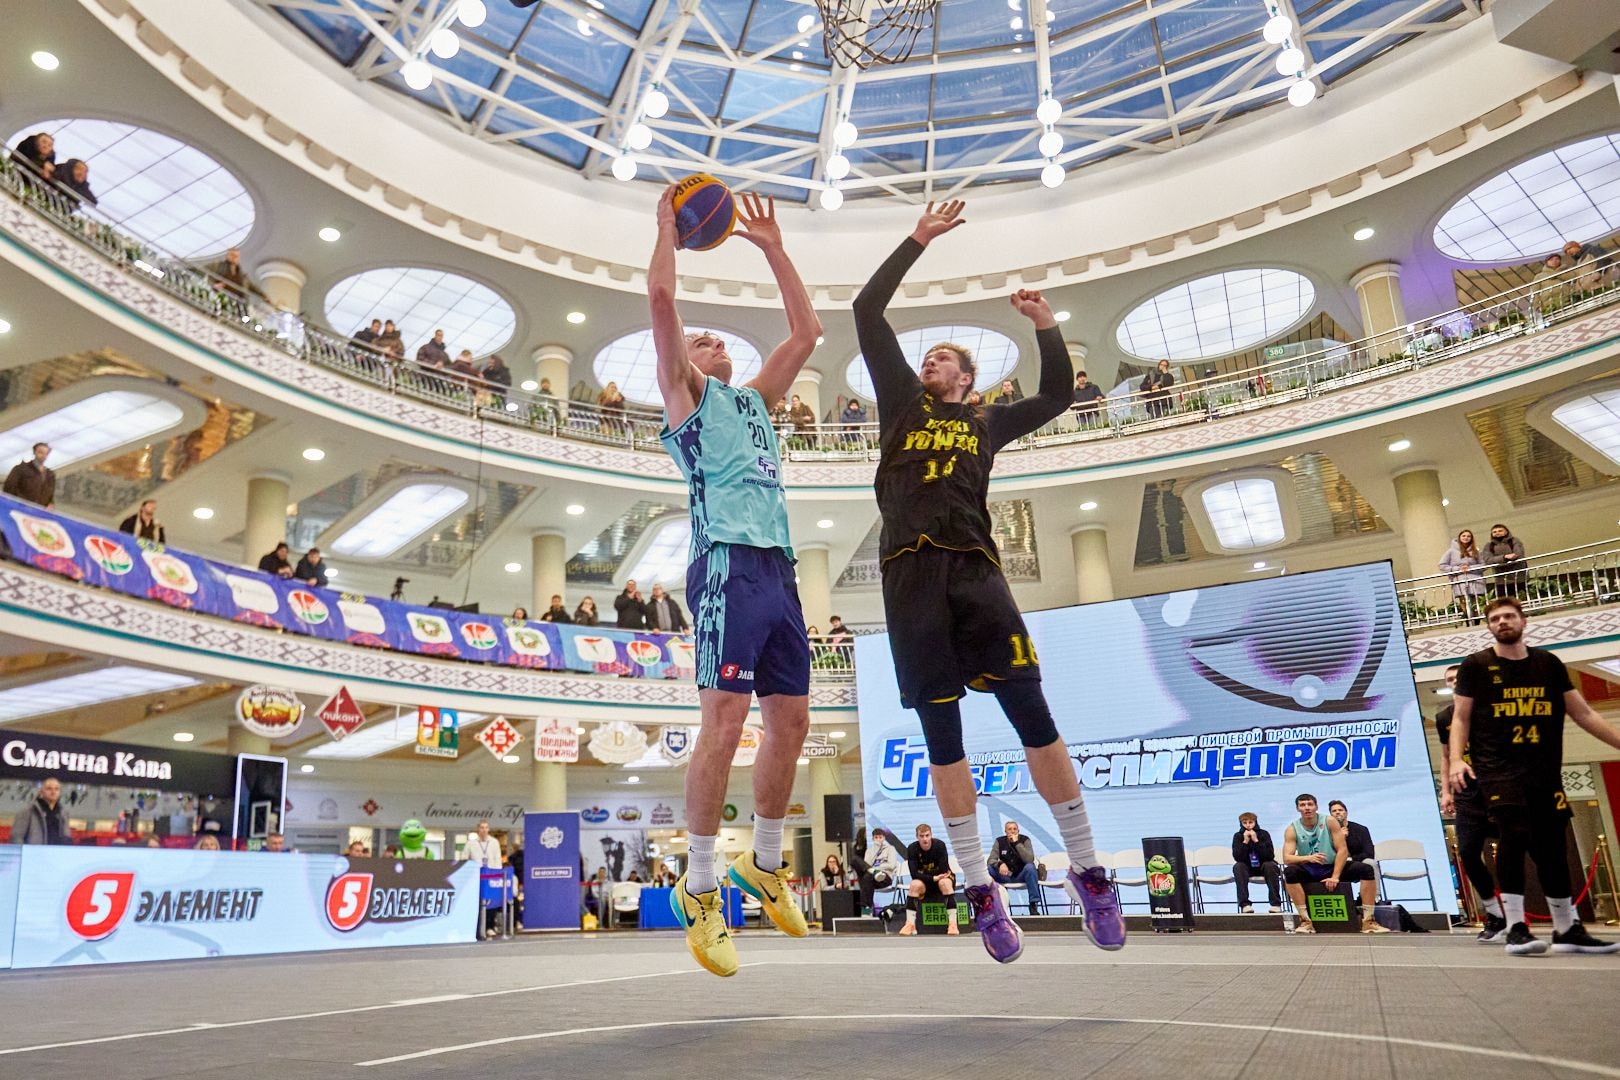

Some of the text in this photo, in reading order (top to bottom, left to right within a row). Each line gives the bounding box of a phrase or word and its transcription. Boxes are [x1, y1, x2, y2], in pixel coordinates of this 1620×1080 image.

[1503, 686, 1545, 699] KHIMKI
[1490, 697, 1553, 718] POWER
[1200, 728, 1262, 748] ПИЩЕВОЙ
[1266, 720, 1399, 743] ПРОМЫШЛЕННОСТИ
[1512, 725, 1541, 744] 24
[3, 740, 172, 780] Смачна Кава
[82, 879, 264, 926] 5 ЭЛЕМЕНТ
[337, 881, 456, 919] 5 ЭЛЕМЕНТ
[1313, 898, 1342, 908] BET
